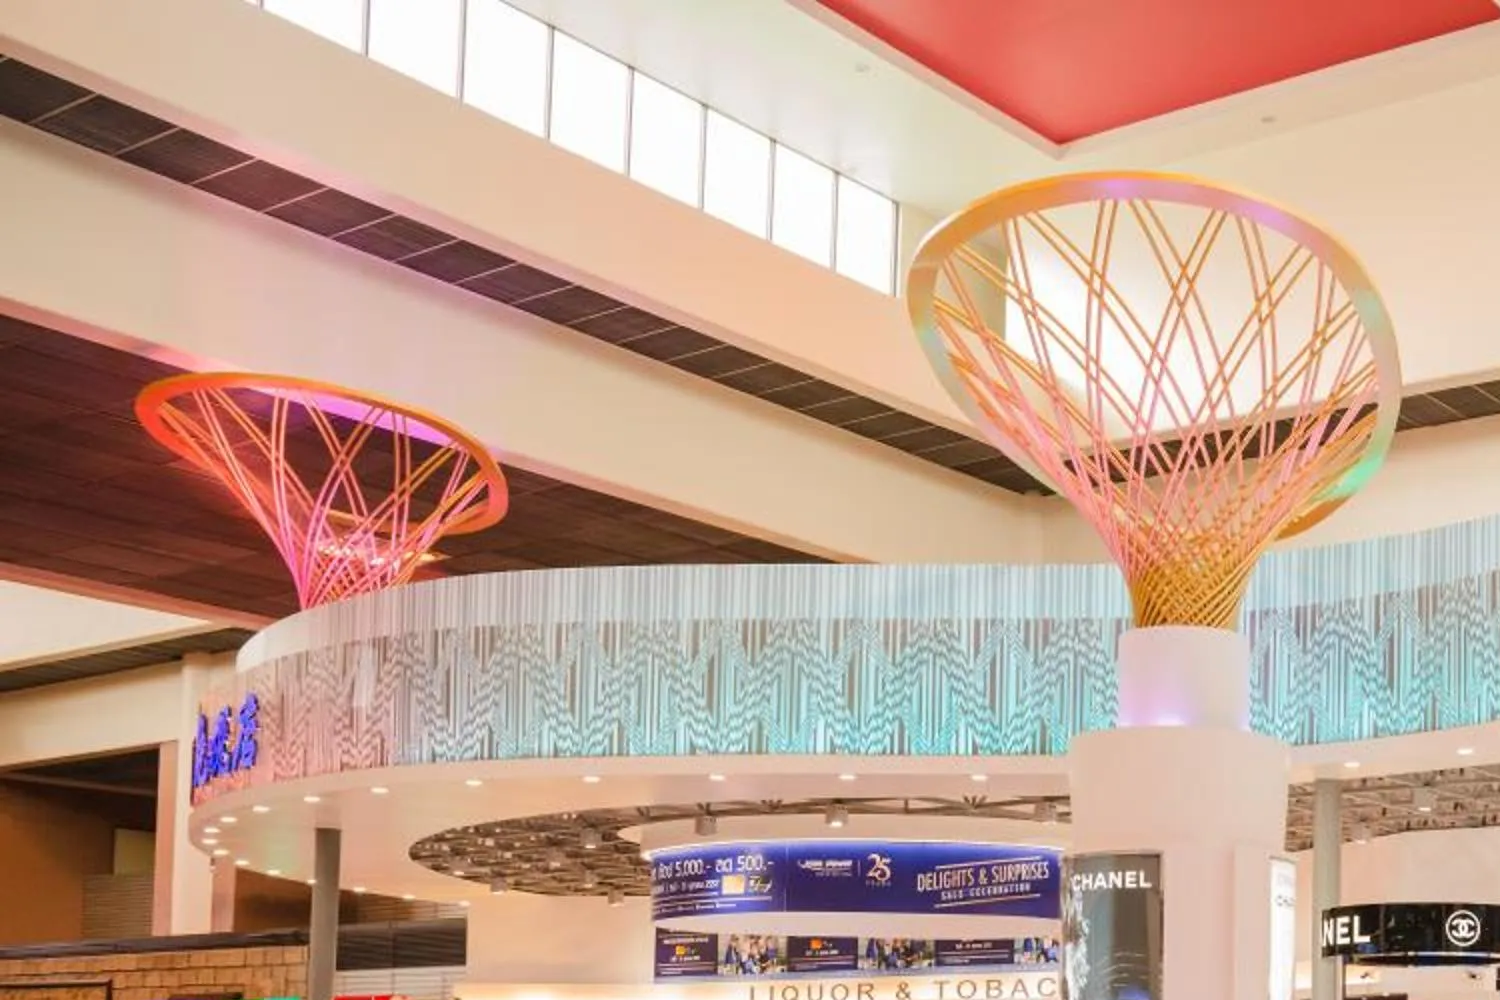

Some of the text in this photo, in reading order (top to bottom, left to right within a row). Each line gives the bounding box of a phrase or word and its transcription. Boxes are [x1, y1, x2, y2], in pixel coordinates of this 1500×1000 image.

[866, 853, 892, 882] 25
[917, 861, 1050, 892] DELIGHTS & SURPRISES
[1070, 869, 1153, 892] CHANEL
[895, 982, 912, 1000] &
[932, 976, 1057, 1000] TOBAC
